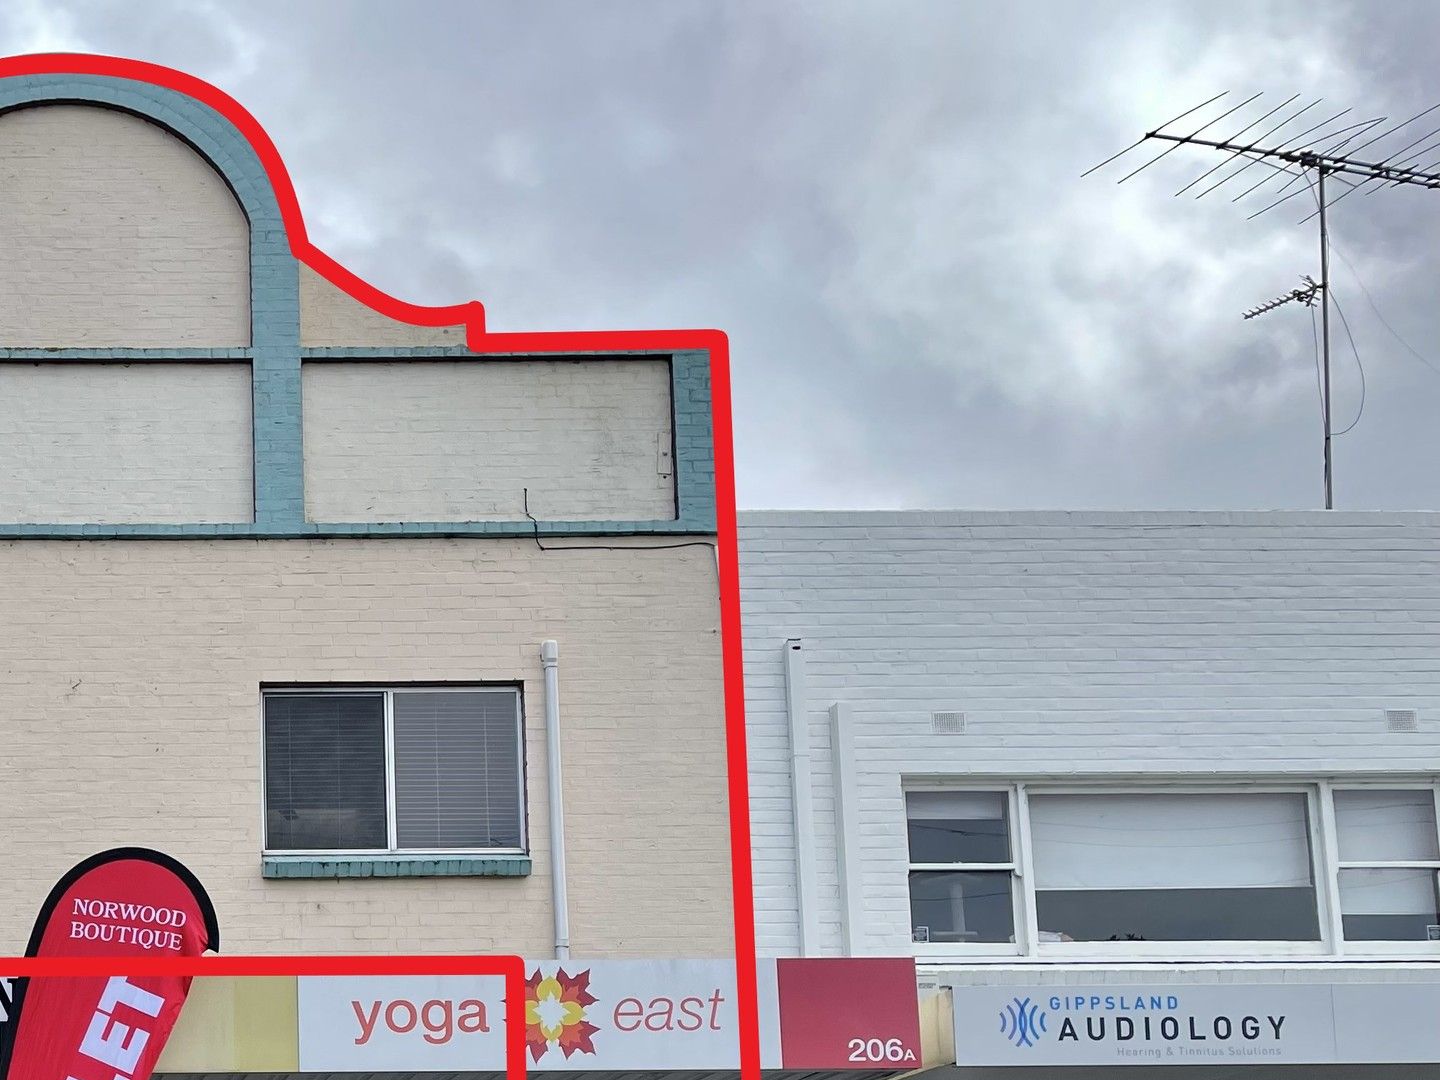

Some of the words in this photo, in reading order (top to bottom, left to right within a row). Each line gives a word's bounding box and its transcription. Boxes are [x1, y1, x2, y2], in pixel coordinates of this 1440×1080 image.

[72, 898, 187, 929] NORWOOD
[70, 920, 182, 951] BOUTIQUE
[351, 998, 490, 1045] yoga
[613, 988, 725, 1032] east
[1049, 995, 1178, 1011] GIPPSLAND
[1058, 1015, 1286, 1041] AUDIOLOGY
[847, 1037, 916, 1064] 206A
[1116, 1046, 1161, 1059] Hearing
[1166, 1046, 1175, 1057] &
[1178, 1046, 1225, 1057] Tinnitus
[1228, 1046, 1282, 1057] Solutions
